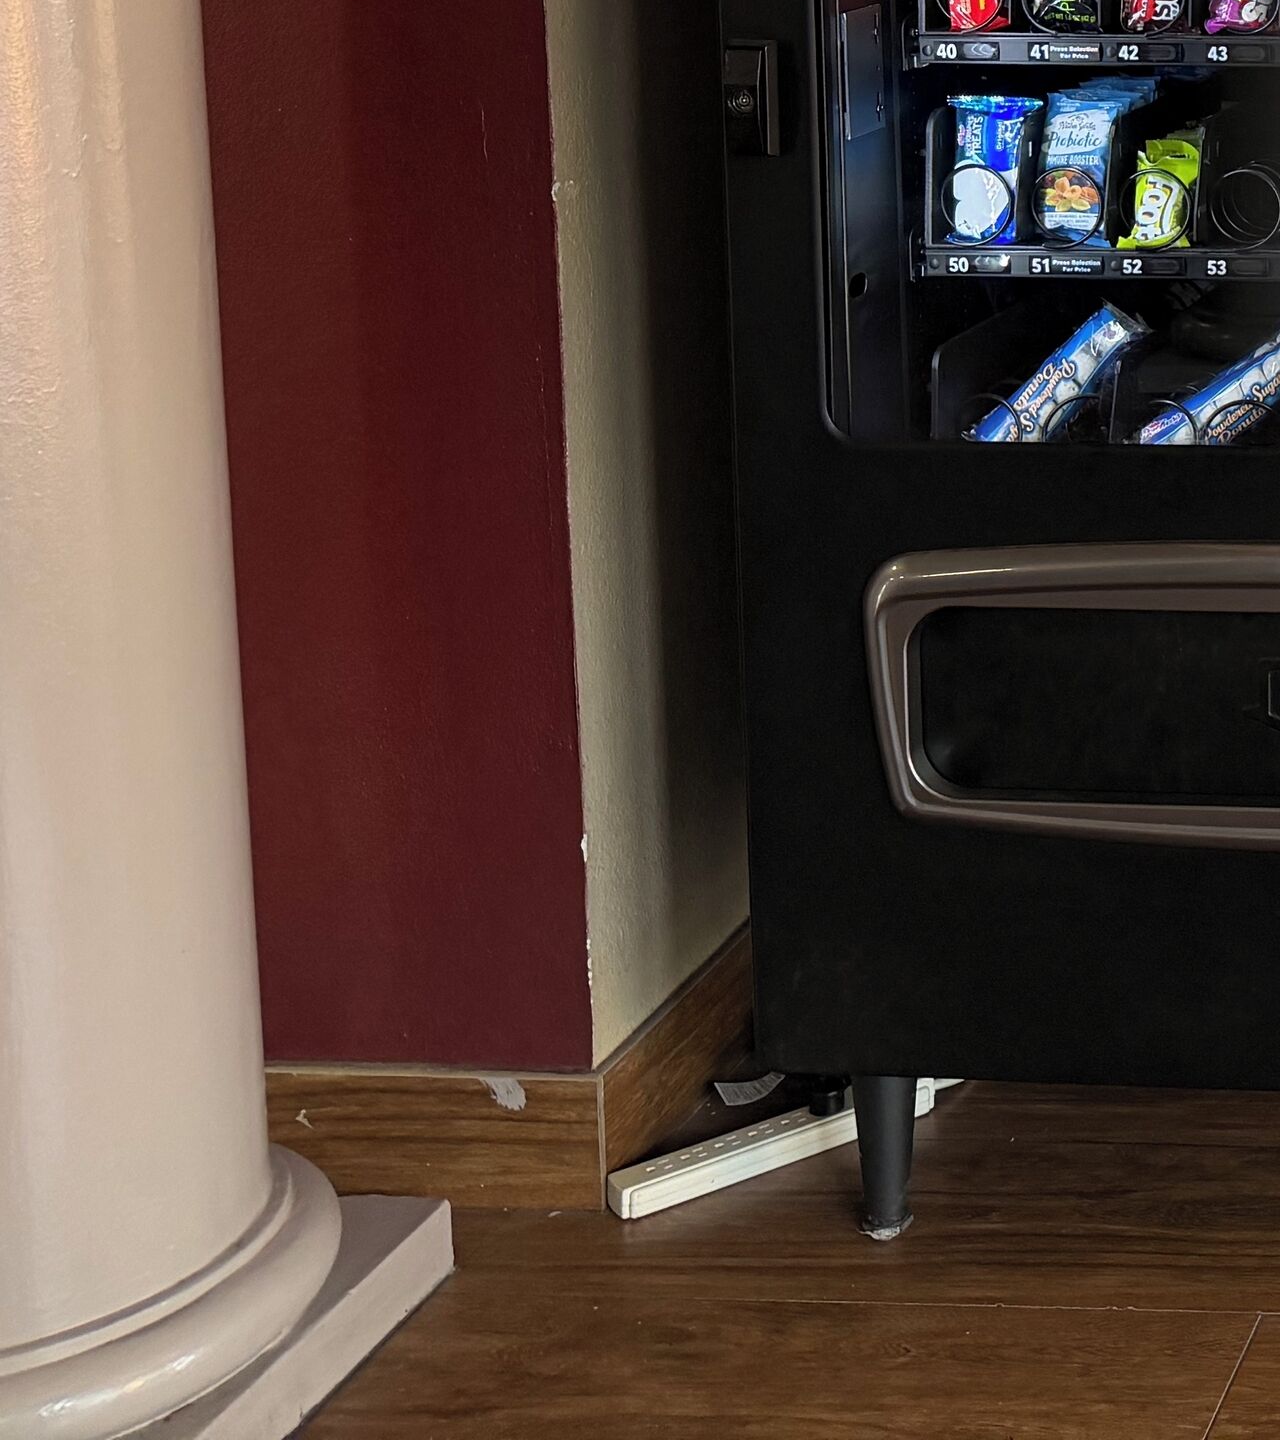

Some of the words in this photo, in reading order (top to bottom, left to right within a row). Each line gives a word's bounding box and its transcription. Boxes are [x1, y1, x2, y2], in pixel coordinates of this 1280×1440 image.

[937, 44, 957, 58] 40
[1031, 45, 1048, 59] 41
[1119, 45, 1138, 60] 42
[1208, 46, 1227, 61] 43
[971, 115, 984, 155] TREATS
[1050, 131, 1102, 149] Probiotic
[950, 257, 968, 272] 50
[1032, 258, 1049, 272] 51
[1123, 259, 1142, 273] 52
[1208, 260, 1226, 275] 53
[1013, 362, 1057, 411] Donuts
[1028, 357, 1077, 419] Powdered
